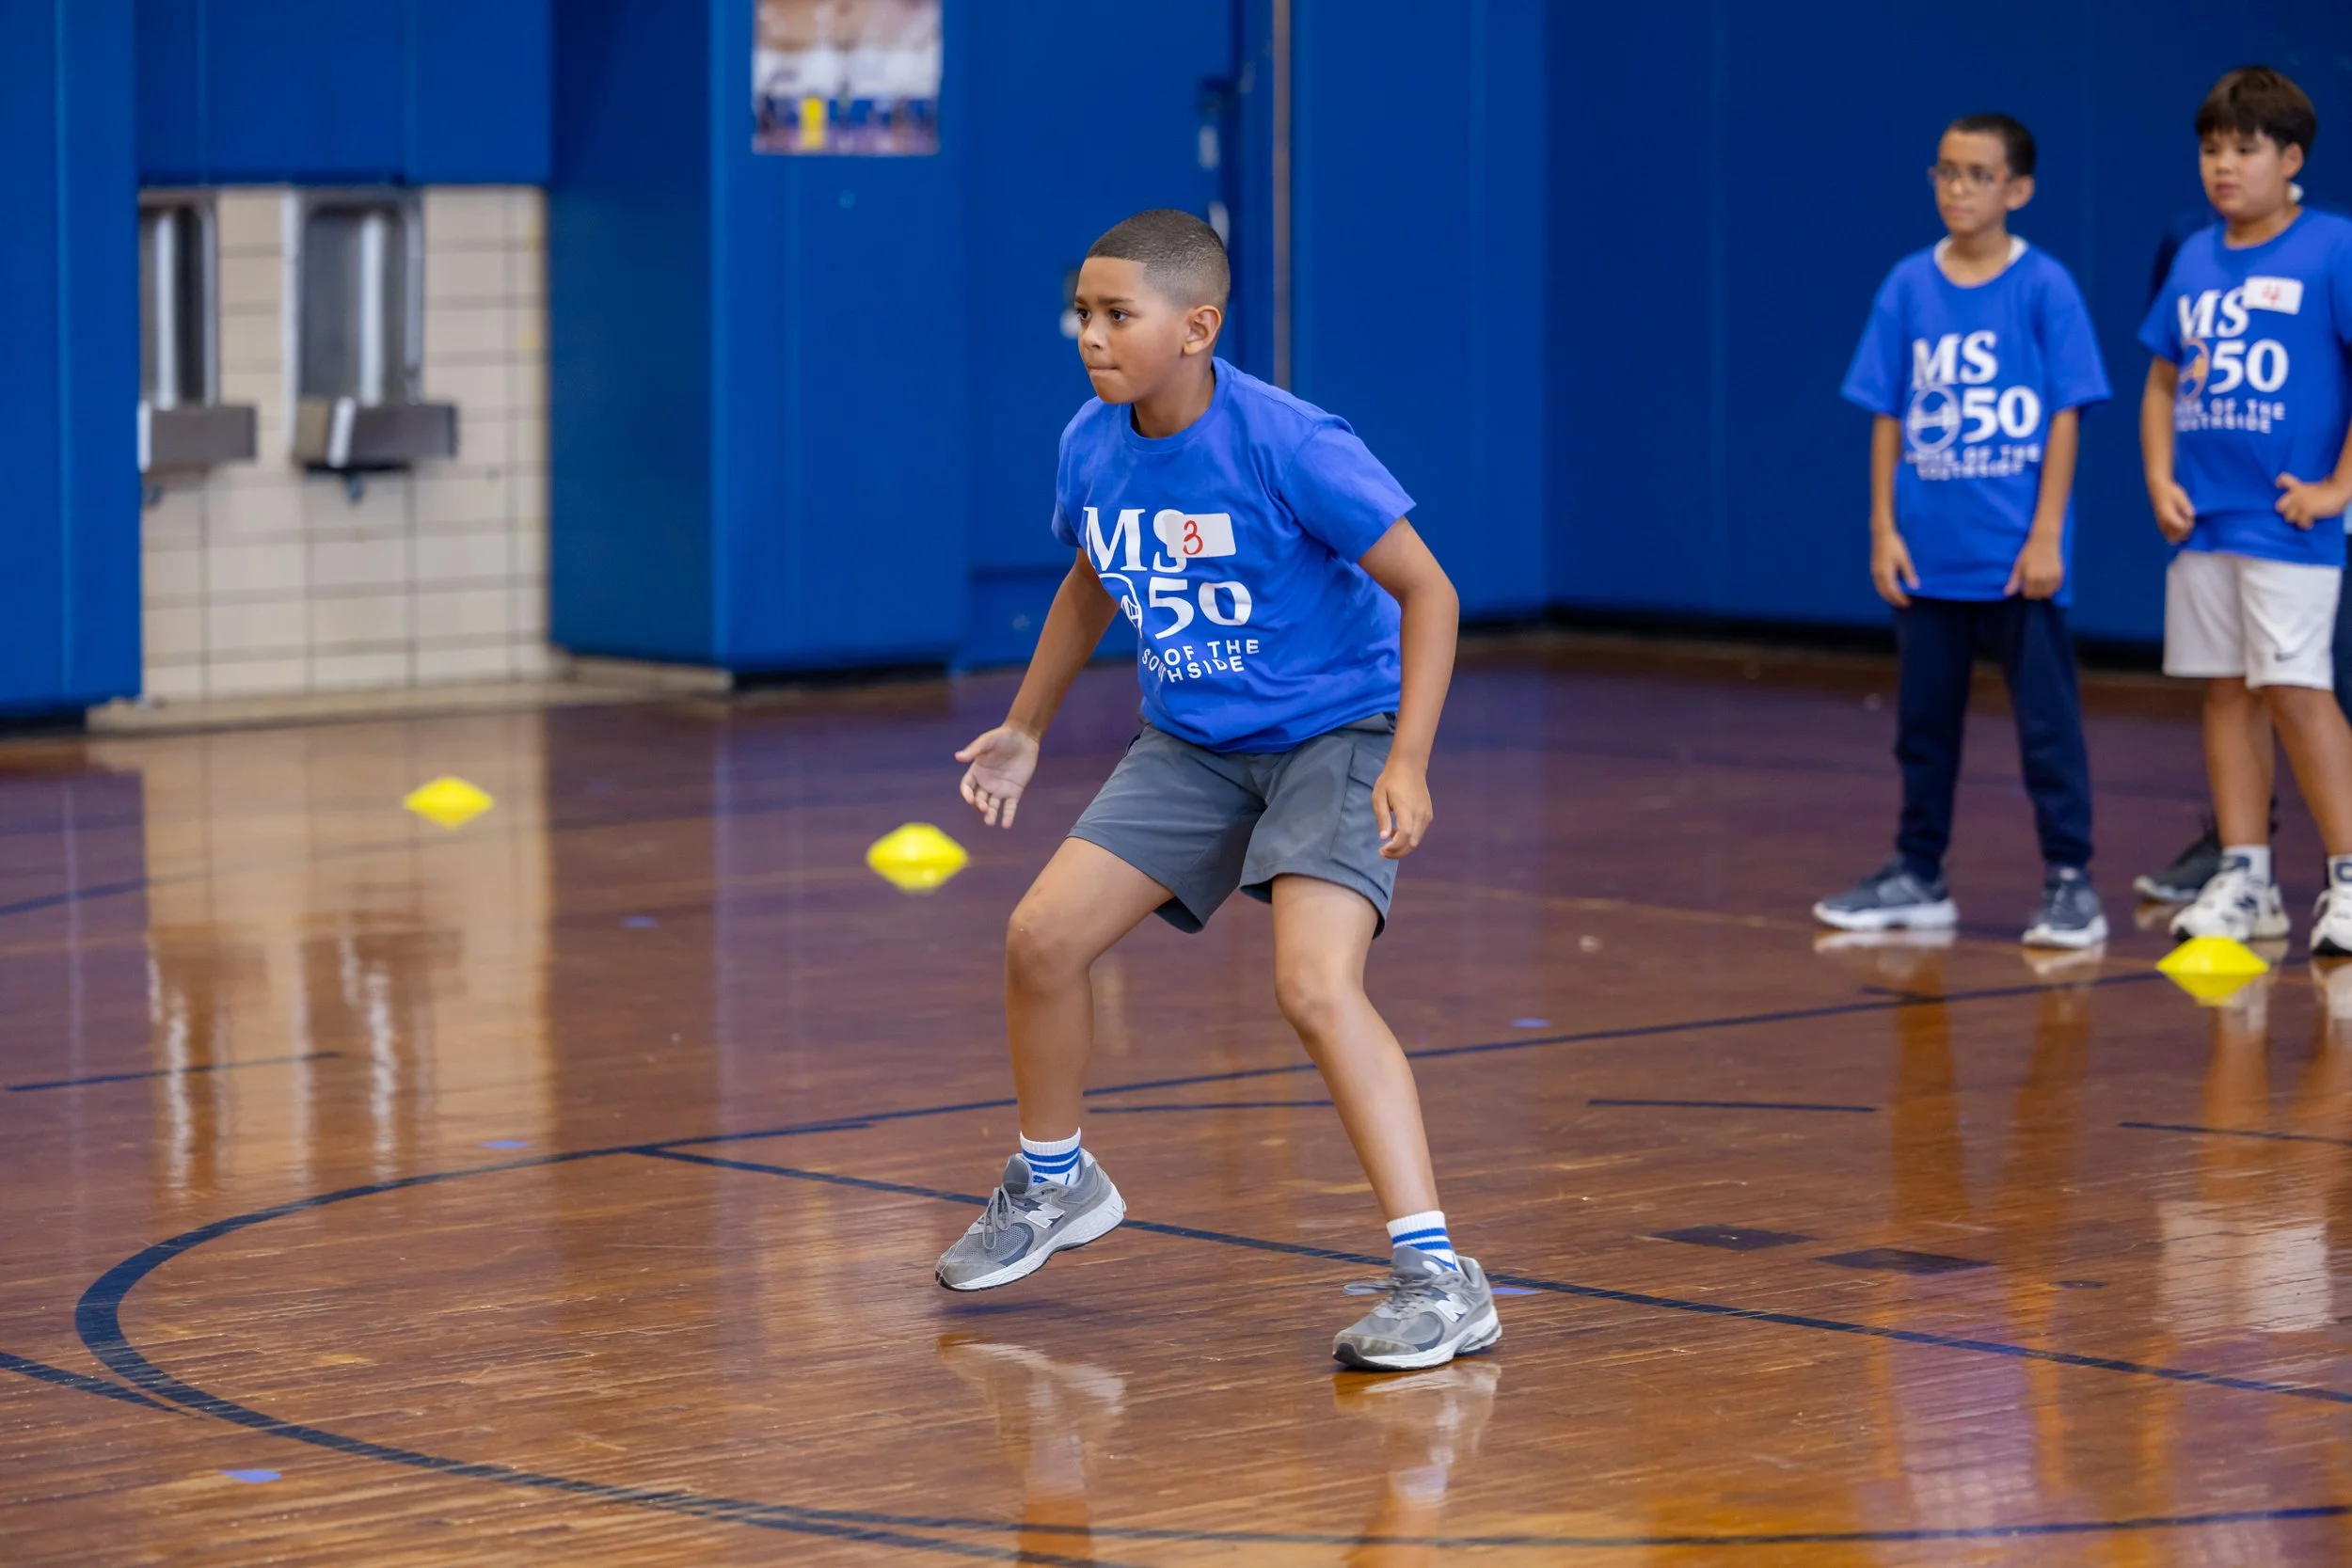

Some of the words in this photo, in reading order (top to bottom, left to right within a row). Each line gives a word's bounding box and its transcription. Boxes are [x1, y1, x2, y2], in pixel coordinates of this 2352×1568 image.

[2177, 286, 2249, 340] MS
[1912, 330, 1998, 389] MS
[2208, 338, 2289, 394] 50
[1963, 385, 2041, 443] 50
[1084, 506, 1187, 574] MS
[1183, 519, 1204, 555] 3
[1149, 577, 1253, 640] 50
[1164, 645, 1195, 666] OF
[1206, 639, 1261, 658] THE
